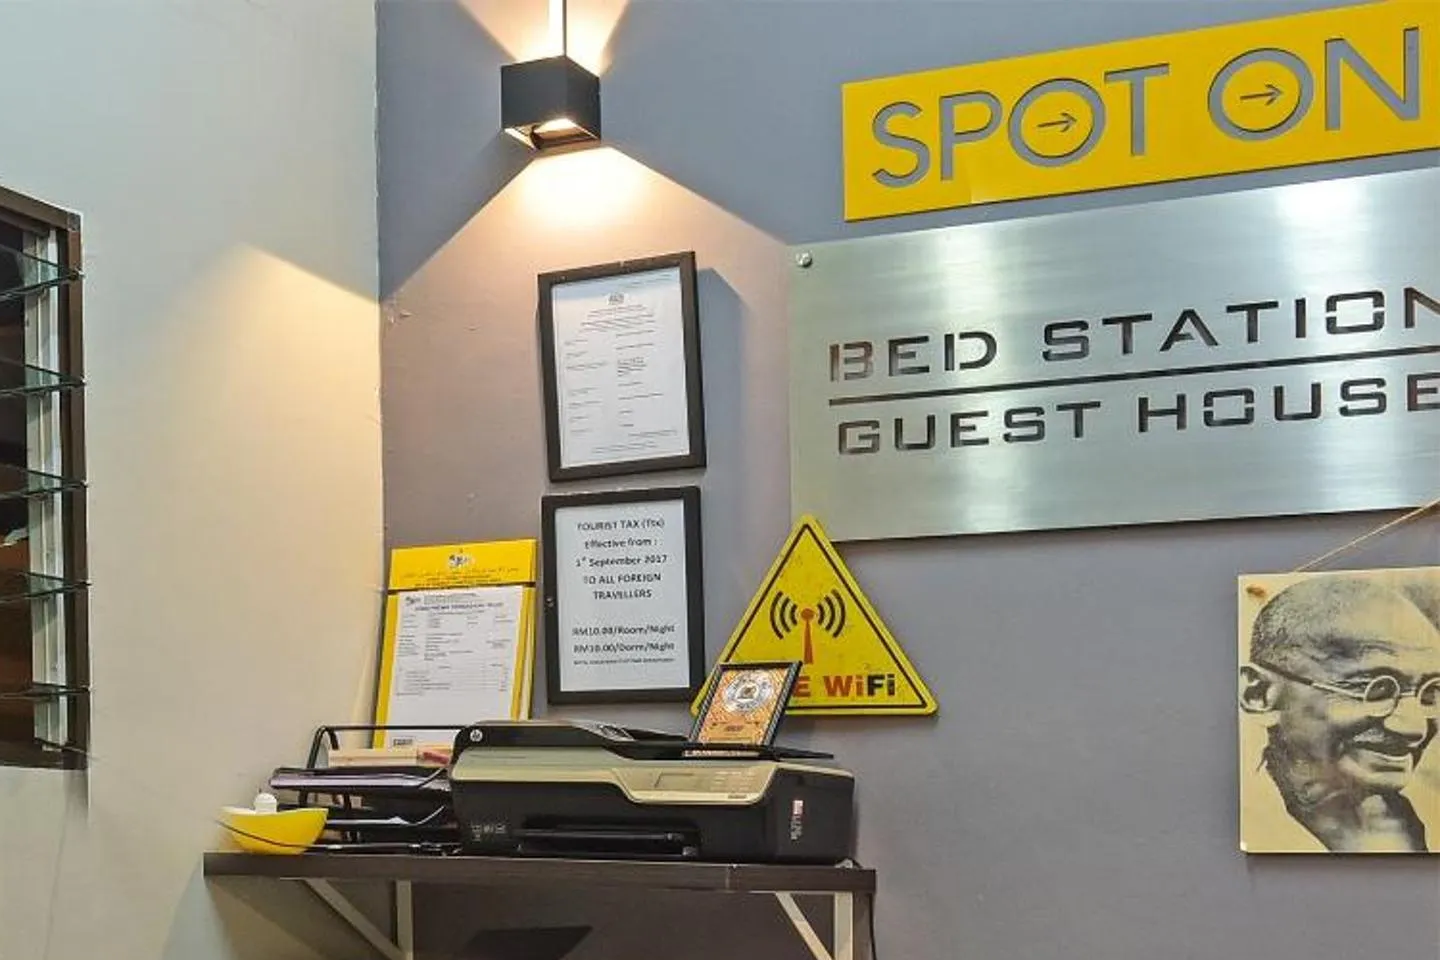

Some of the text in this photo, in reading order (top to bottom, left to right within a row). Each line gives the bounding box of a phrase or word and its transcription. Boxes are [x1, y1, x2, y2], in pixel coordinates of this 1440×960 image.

[870, 25, 1421, 189] SPOT ON
[829, 287, 1440, 383] BED STATION
[838, 371, 1440, 456] GUEST HOUSE
[620, 519, 640, 529] TAX
[599, 575, 615, 584] ALL
[593, 589, 652, 600] TRAVELLERS
[823, 673, 896, 698] WiFi
